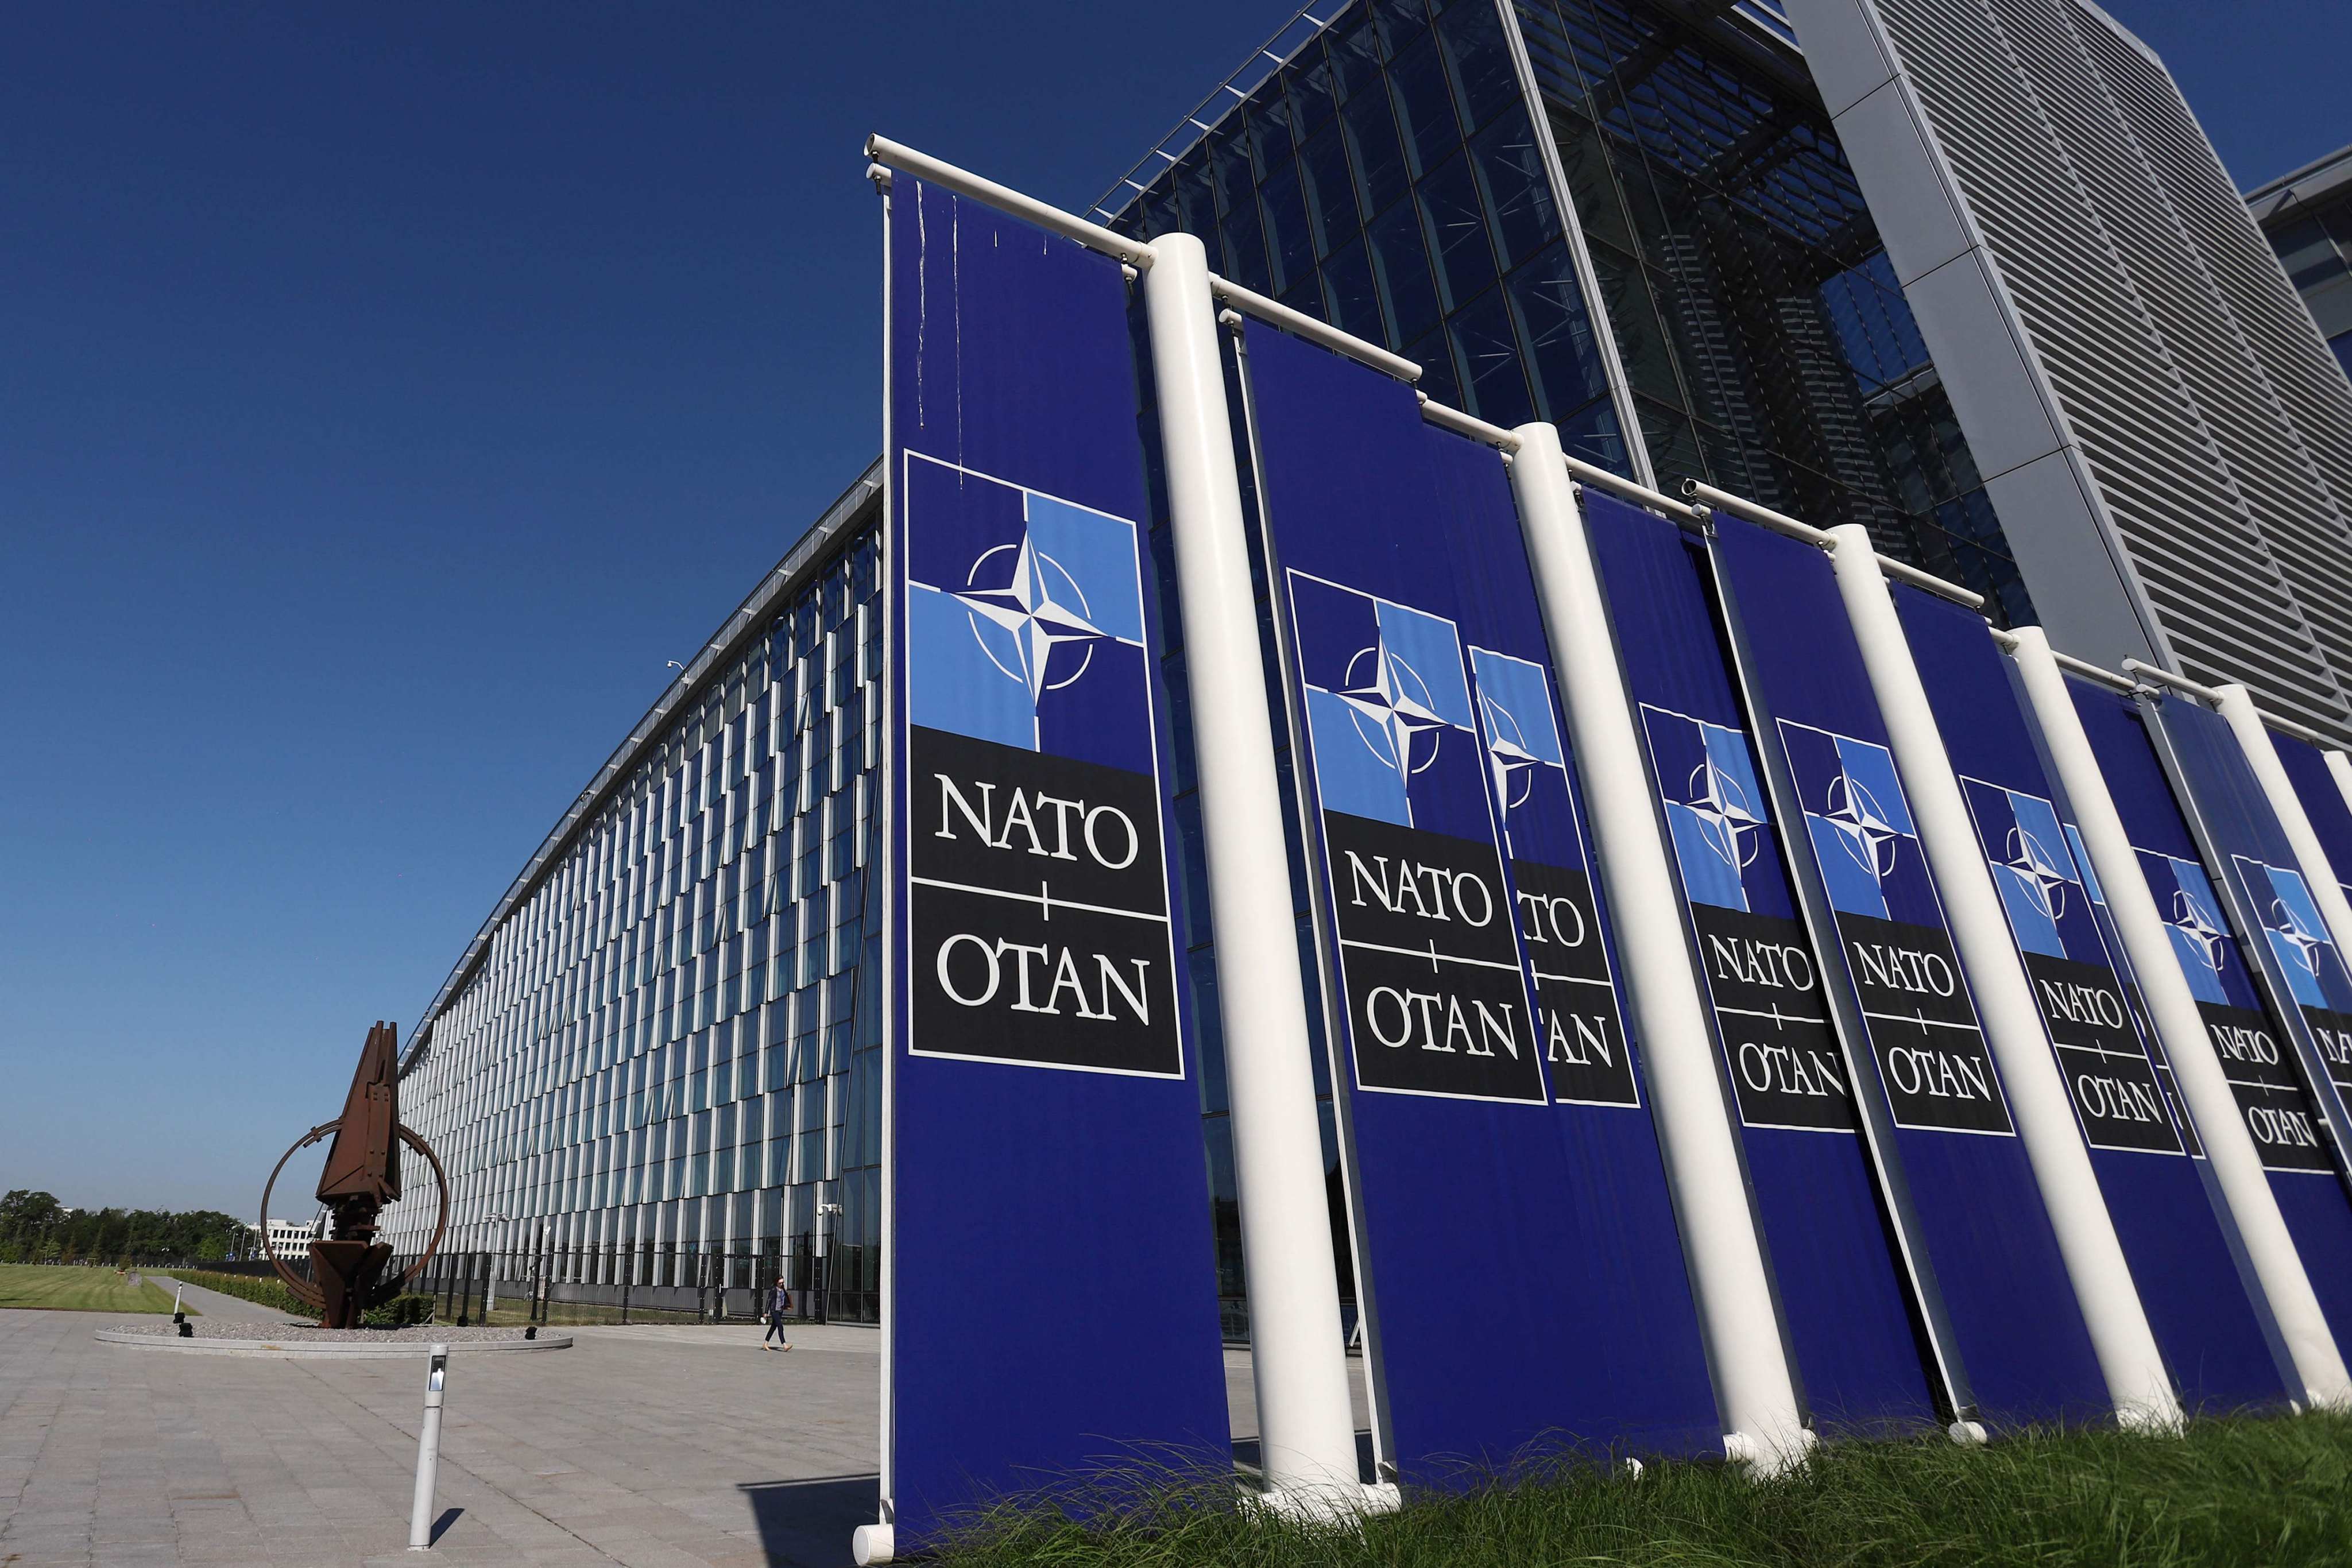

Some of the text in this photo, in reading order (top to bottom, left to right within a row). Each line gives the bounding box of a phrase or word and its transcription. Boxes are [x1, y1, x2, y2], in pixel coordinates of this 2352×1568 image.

[934, 773, 1138, 869] NATO
[1345, 850, 1492, 927] NATO
[1517, 890, 1584, 947] TO
[937, 934, 1150, 1025] OTAN
[1708, 934, 1815, 991] NATO
[1853, 942, 1954, 996] NATO
[1367, 987, 1518, 1060] OTAN
[2040, 979, 2122, 1028] NATO
[1539, 1008, 1612, 1068] AN
[2210, 1025, 2278, 1065] NATO
[1739, 1043, 1848, 1098] OTAN
[1889, 1047, 1991, 1101] OTAN
[2078, 1075, 2162, 1124] OTAN
[2249, 1107, 2318, 1147] OTAN
